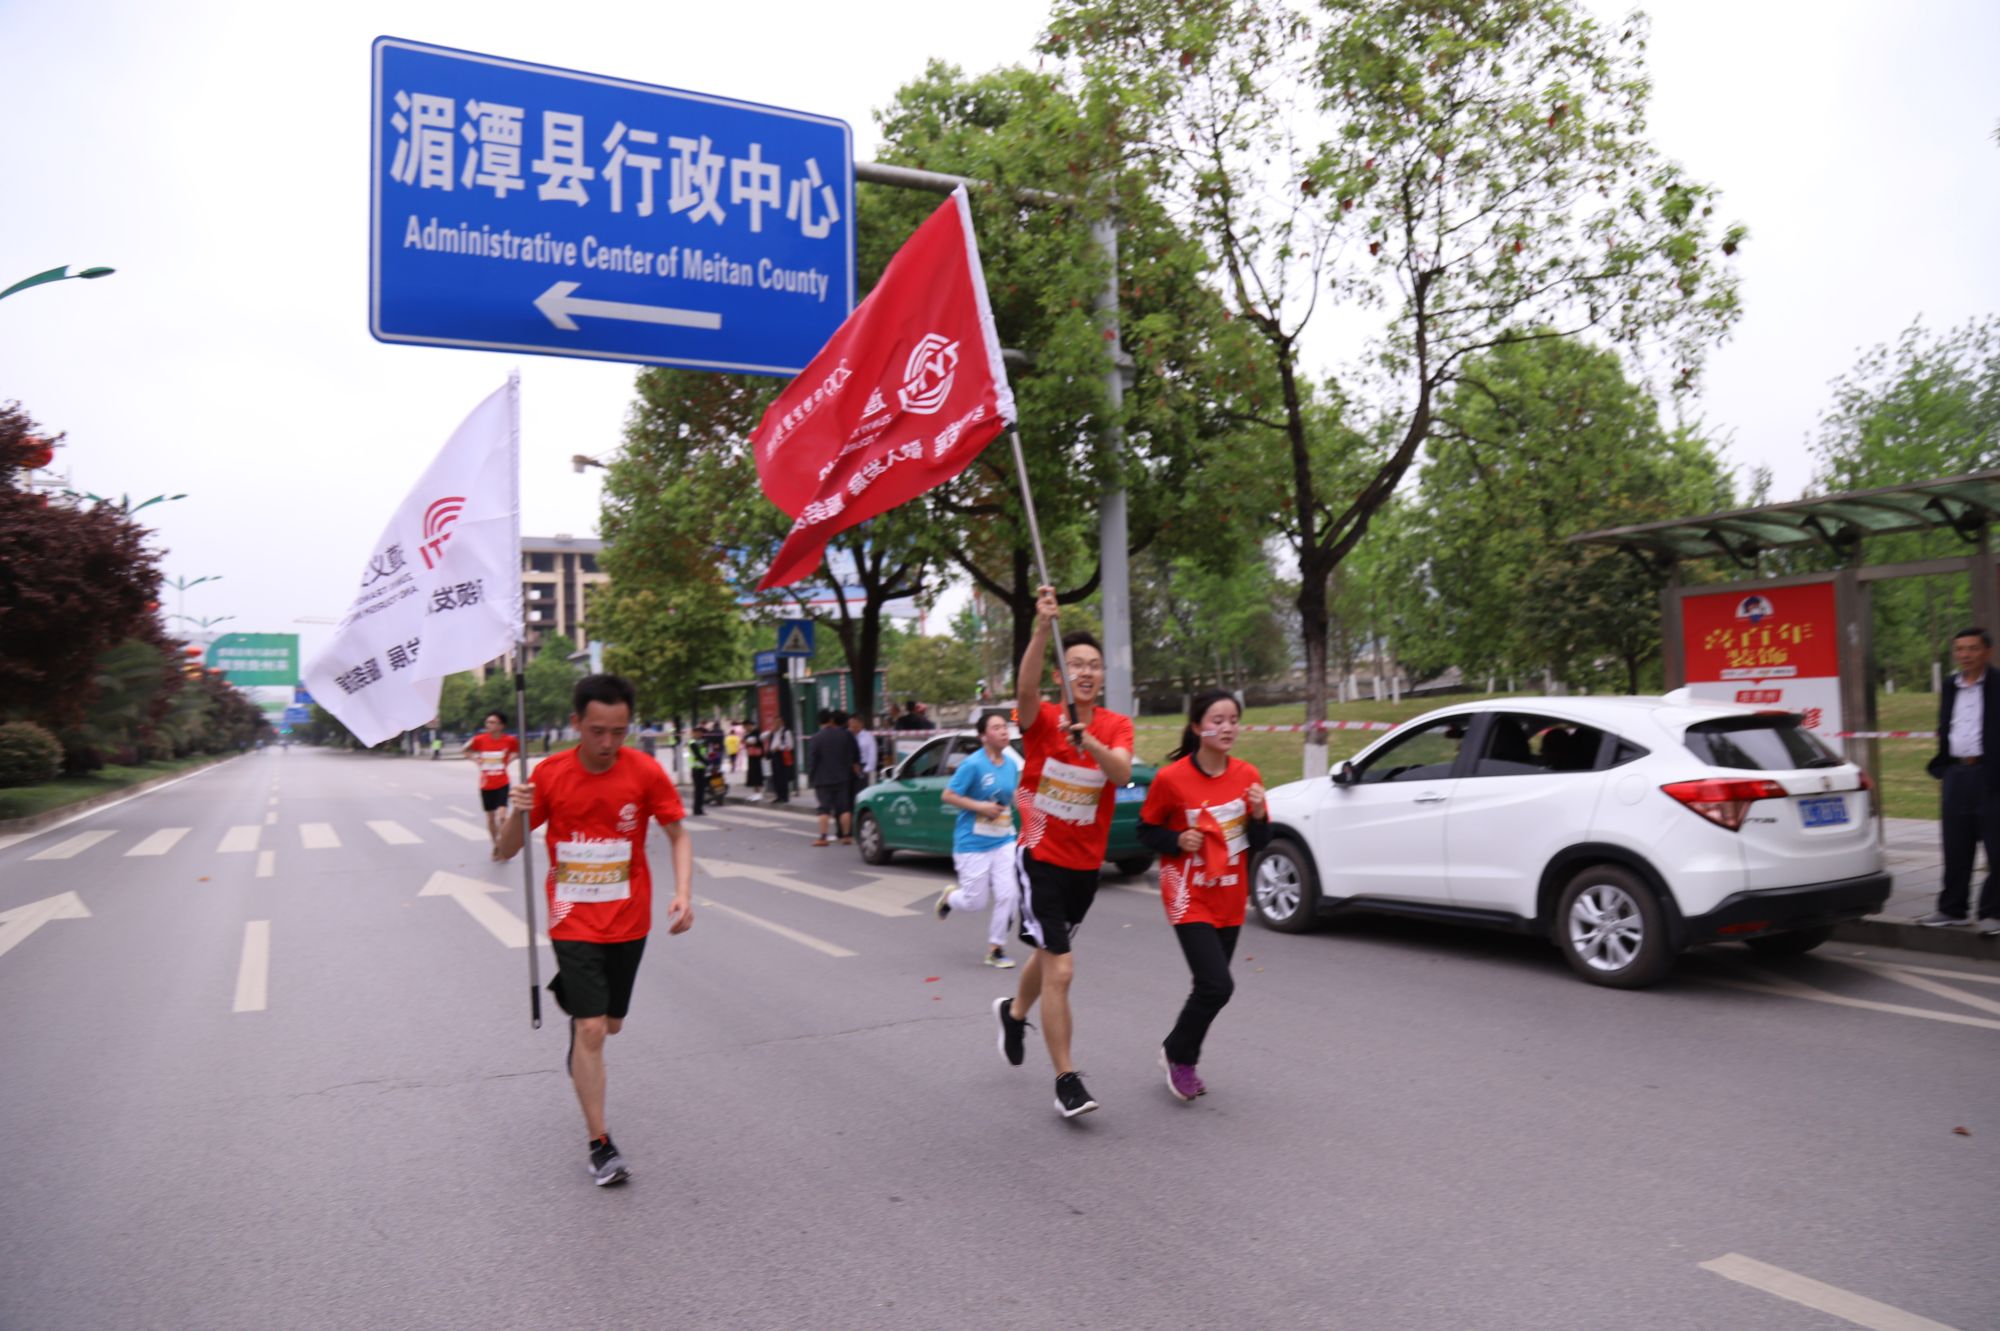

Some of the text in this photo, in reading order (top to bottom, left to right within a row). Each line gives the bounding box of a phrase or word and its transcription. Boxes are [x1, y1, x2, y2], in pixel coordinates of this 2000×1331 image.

[389, 89, 841, 240] 湄潭县行政中心
[403, 214, 829, 303] Administrative Center of Meitan County
